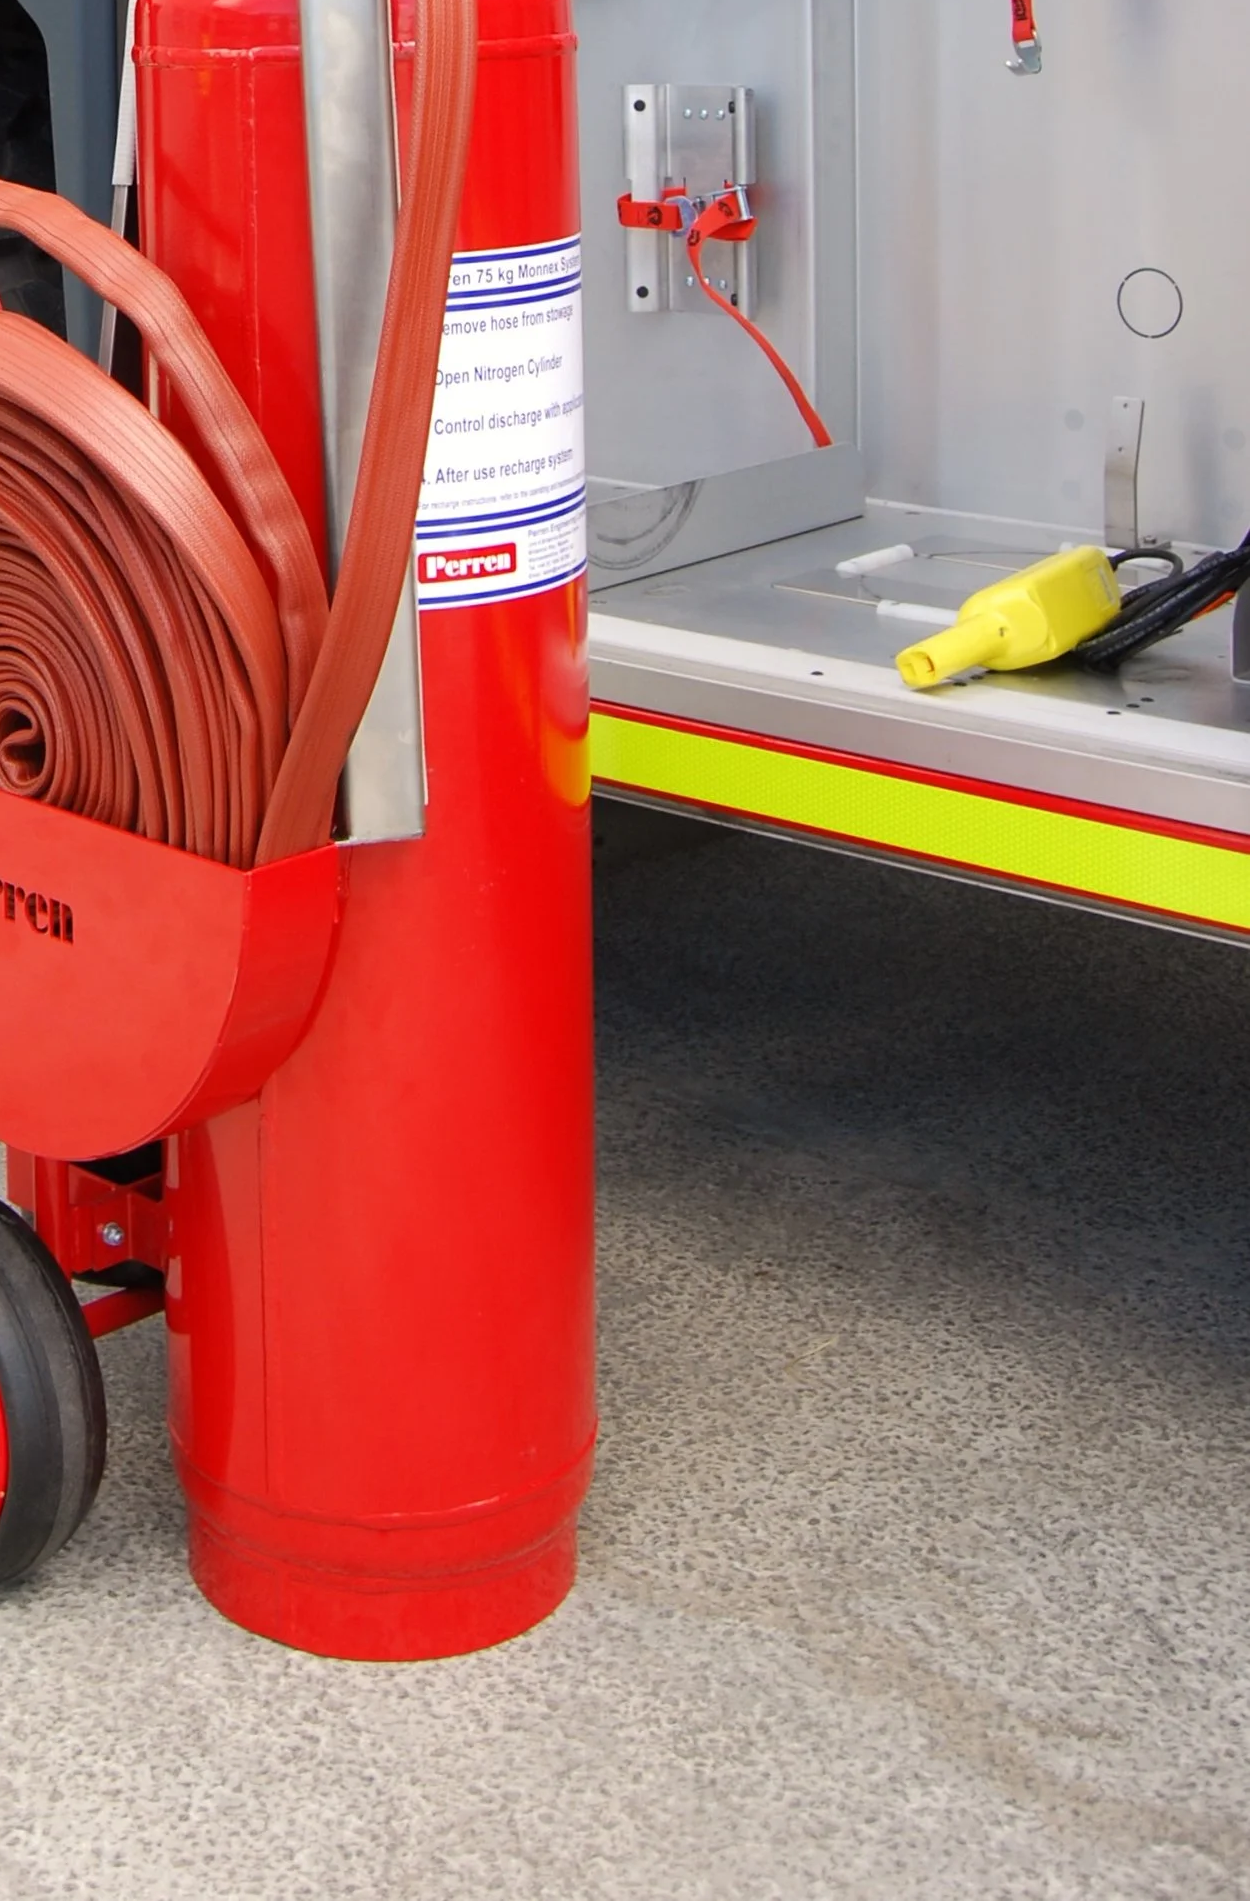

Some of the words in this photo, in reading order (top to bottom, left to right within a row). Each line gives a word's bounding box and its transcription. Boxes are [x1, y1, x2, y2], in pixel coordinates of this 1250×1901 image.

[476, 269, 493, 283] 75
[498, 267, 514, 284] kg
[518, 263, 559, 279] Monnex
[443, 320, 486, 335] emove
[491, 316, 519, 331] hose
[522, 311, 544, 327] from
[474, 364, 525, 382] Nitrogen
[527, 354, 563, 378] Cylinder
[434, 415, 484, 435] Control
[488, 409, 542, 429] discharge
[435, 467, 470, 483] After
[473, 466, 496, 481] use
[500, 456, 546, 478] recharge
[548, 448, 573, 470] system
[425, 552, 511, 579] Perren
